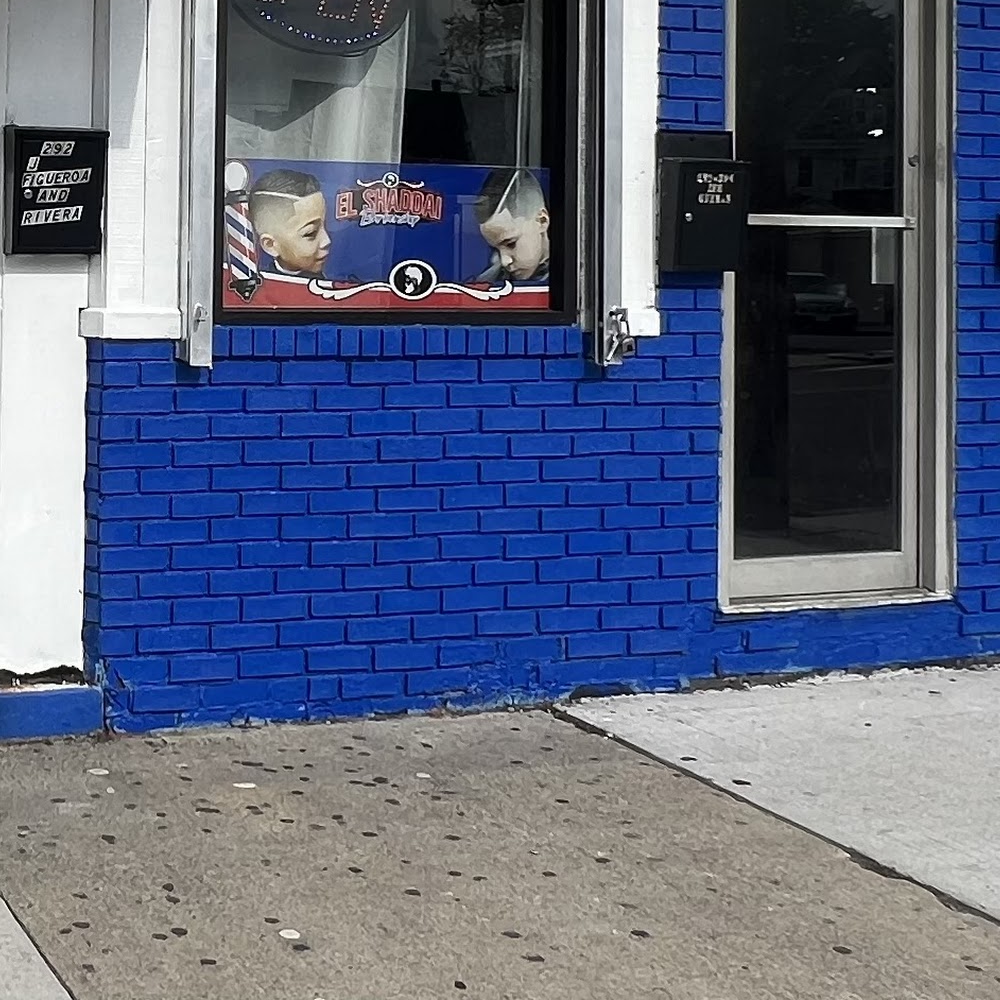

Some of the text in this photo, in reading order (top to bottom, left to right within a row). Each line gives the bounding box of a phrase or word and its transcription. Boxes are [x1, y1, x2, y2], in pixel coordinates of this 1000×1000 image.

[41, 142, 74, 156] 292
[28, 157, 39, 170] J
[22, 169, 91, 187] FIGUEROA
[37, 188, 69, 202] AND
[336, 188, 443, 221] EL SHADDAI
[23, 207, 82, 225] RIVERA
